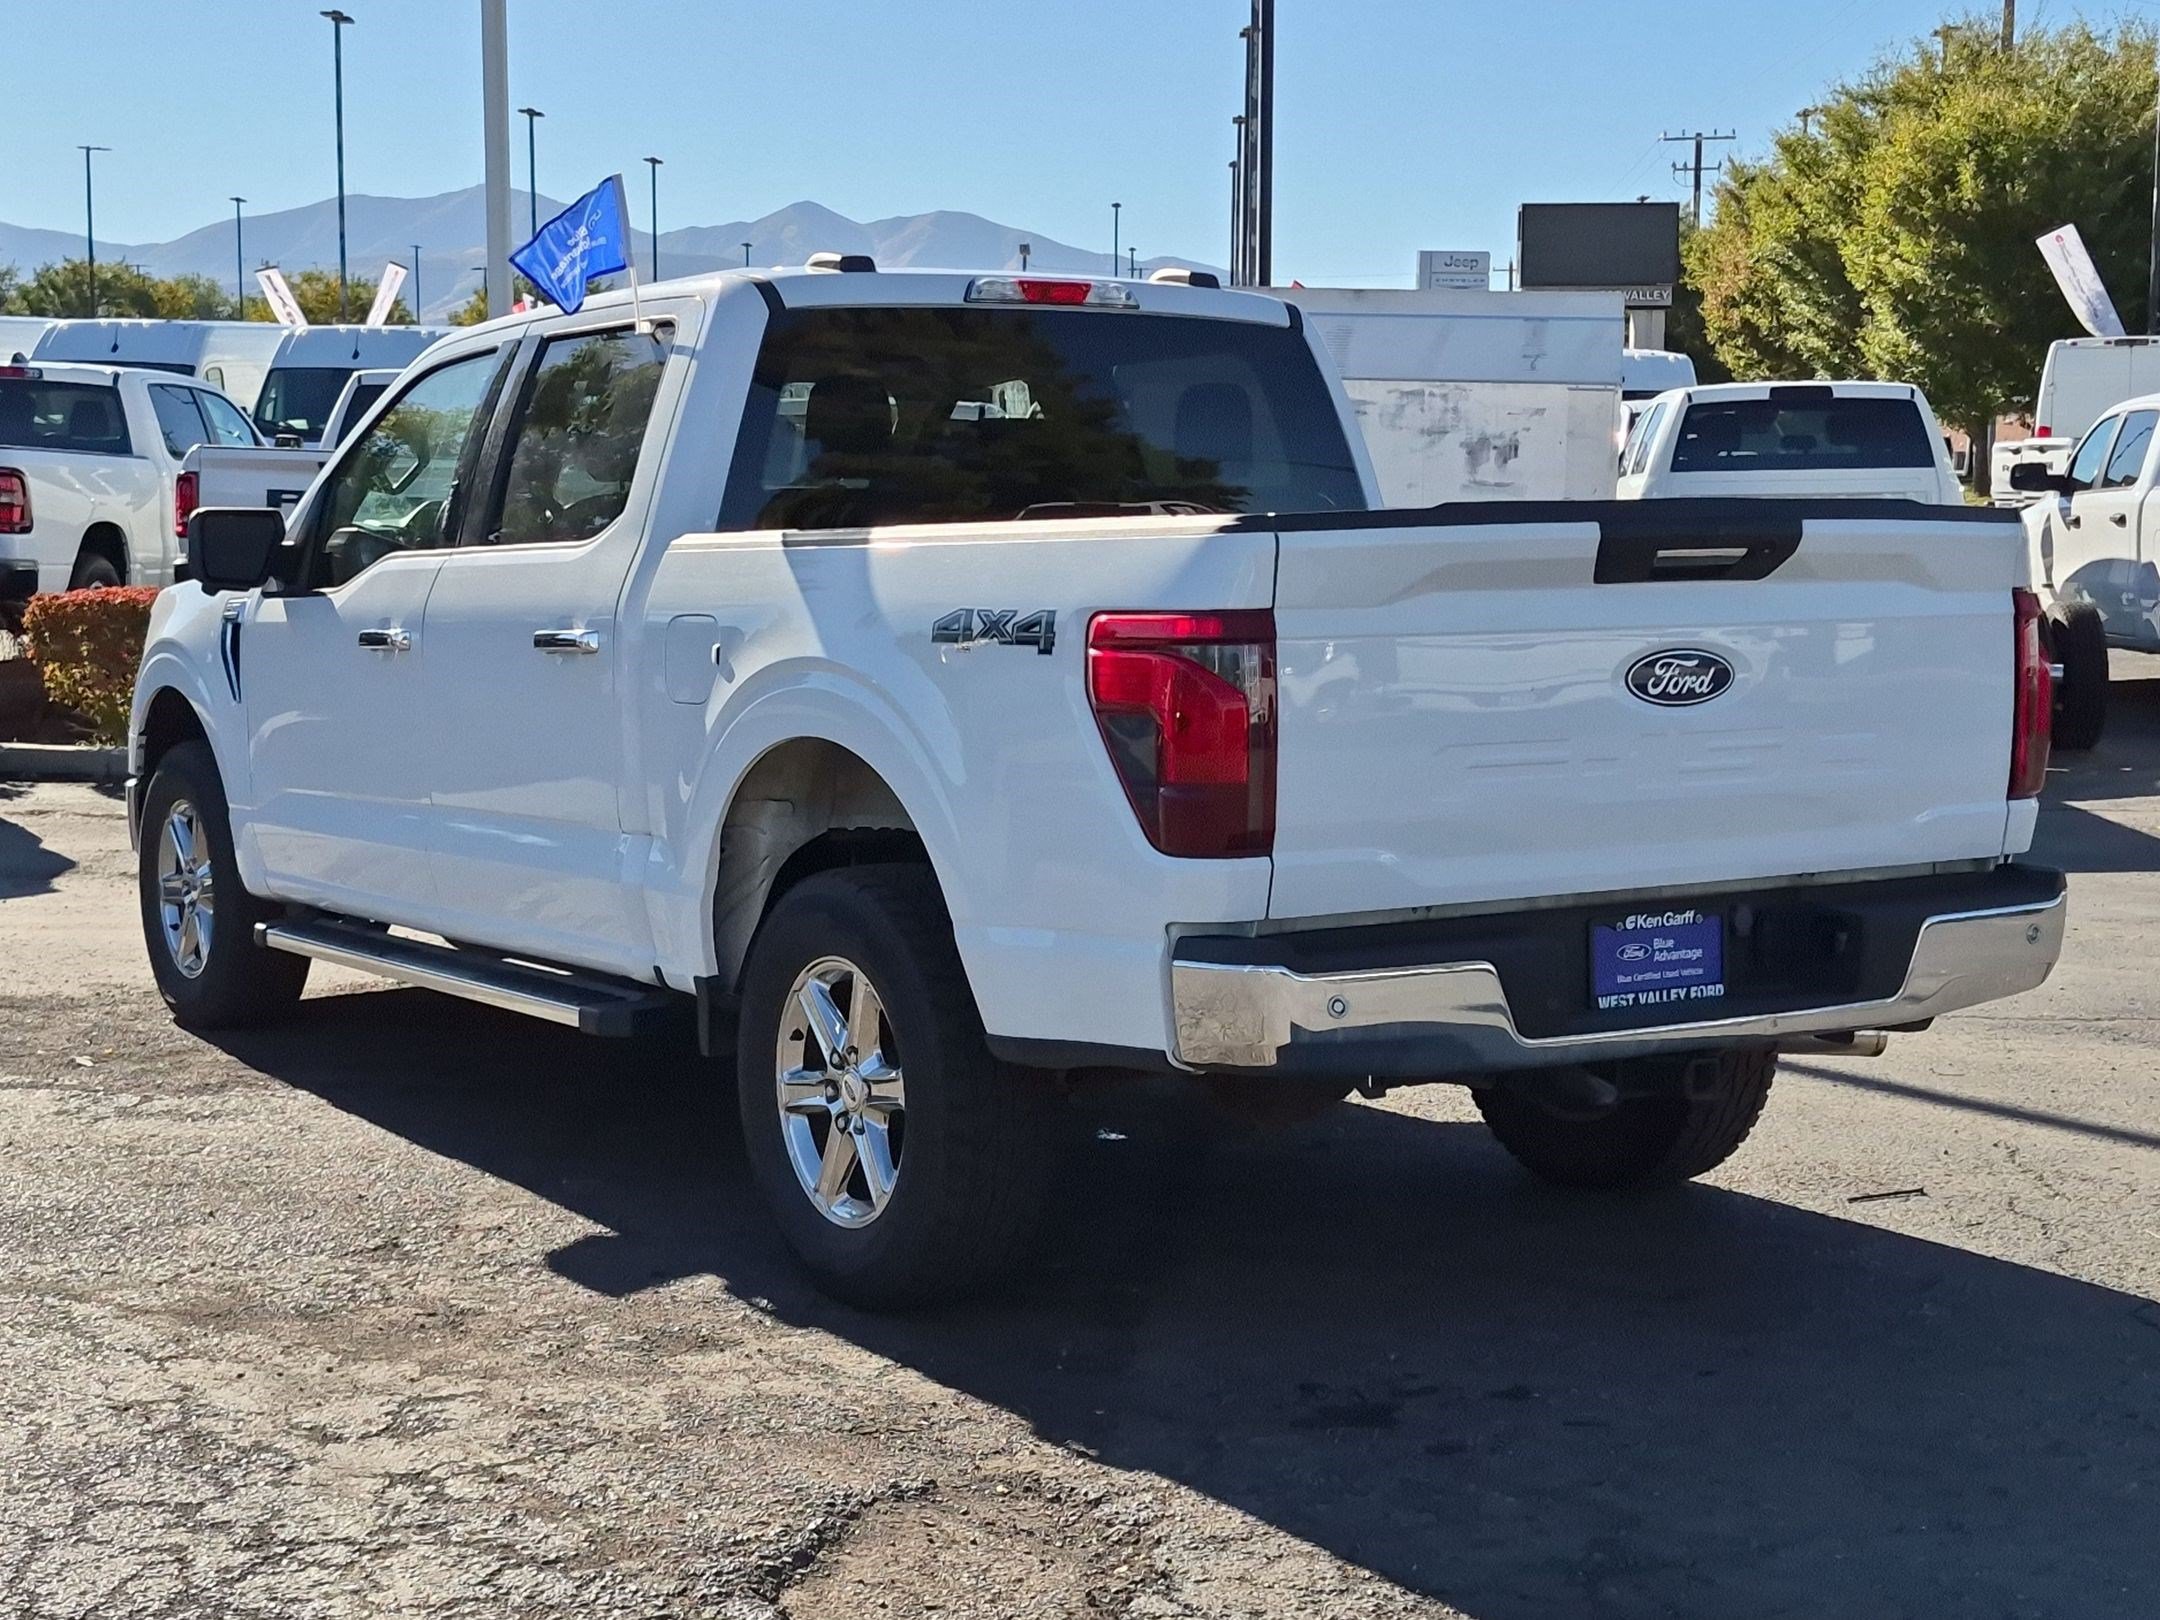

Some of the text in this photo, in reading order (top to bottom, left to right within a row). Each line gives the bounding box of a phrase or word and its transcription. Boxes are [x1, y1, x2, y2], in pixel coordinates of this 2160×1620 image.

[1444, 255, 1479, 271] Jeep
[1624, 289, 1669, 300] VALLEY
[1647, 658, 1715, 696] Ford
[1637, 914, 1662, 930] Ken
[1663, 909, 1695, 926] Garff
[1653, 938, 1675, 950] Blue
[1653, 948, 1703, 962] Advantage
[1598, 983, 1724, 1009] WEST VALLEY FORD
